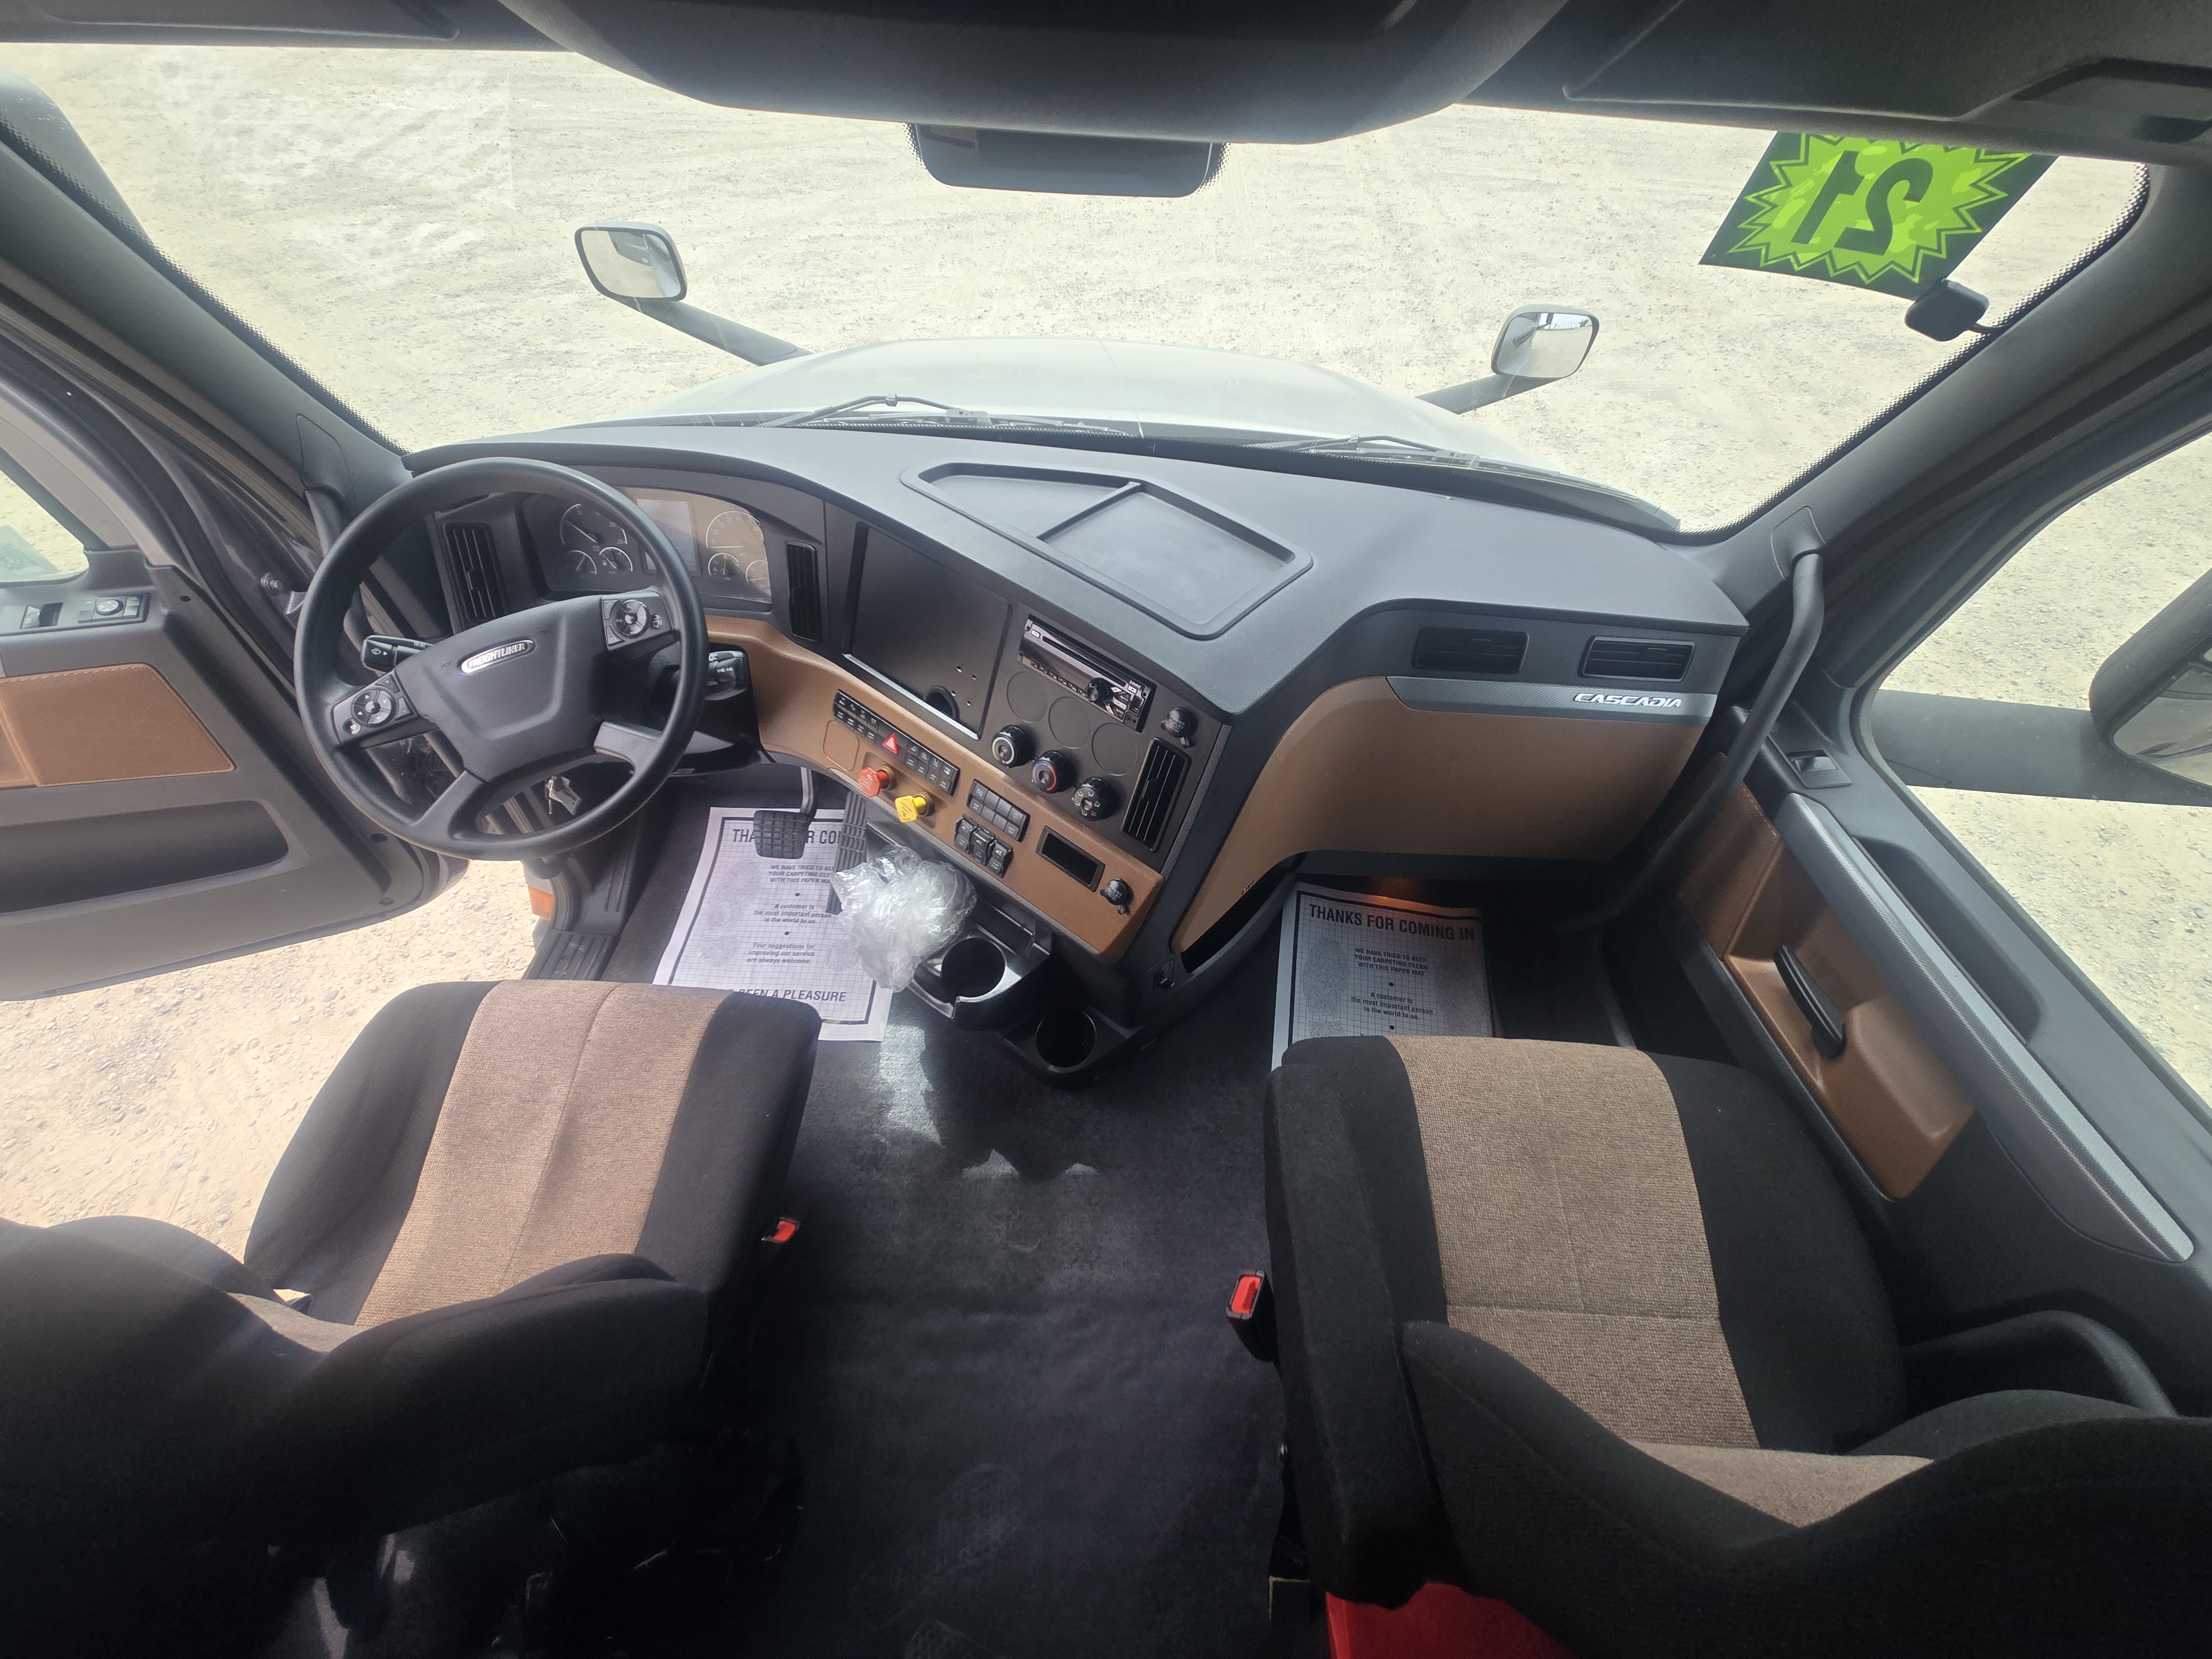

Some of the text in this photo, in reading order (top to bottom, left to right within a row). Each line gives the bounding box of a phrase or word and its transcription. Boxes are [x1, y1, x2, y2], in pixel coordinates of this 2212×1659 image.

[469, 642, 525, 668] FREIGHTLINER
[1574, 693, 1682, 707] CASCADIA
[1169, 718, 1184, 729] OUTLET
[1171, 715, 1185, 726] POWER
[1108, 887, 1120, 899] OUTLET
[1109, 885, 1122, 896] POWER
[1310, 904, 1474, 940] THANKS FOR COMING IN
[1373, 957, 1407, 967] CARPETING
[784, 990, 847, 1001] PLEASURE
[1377, 993, 1405, 1003] customer
[1380, 1001, 1410, 1011] important
